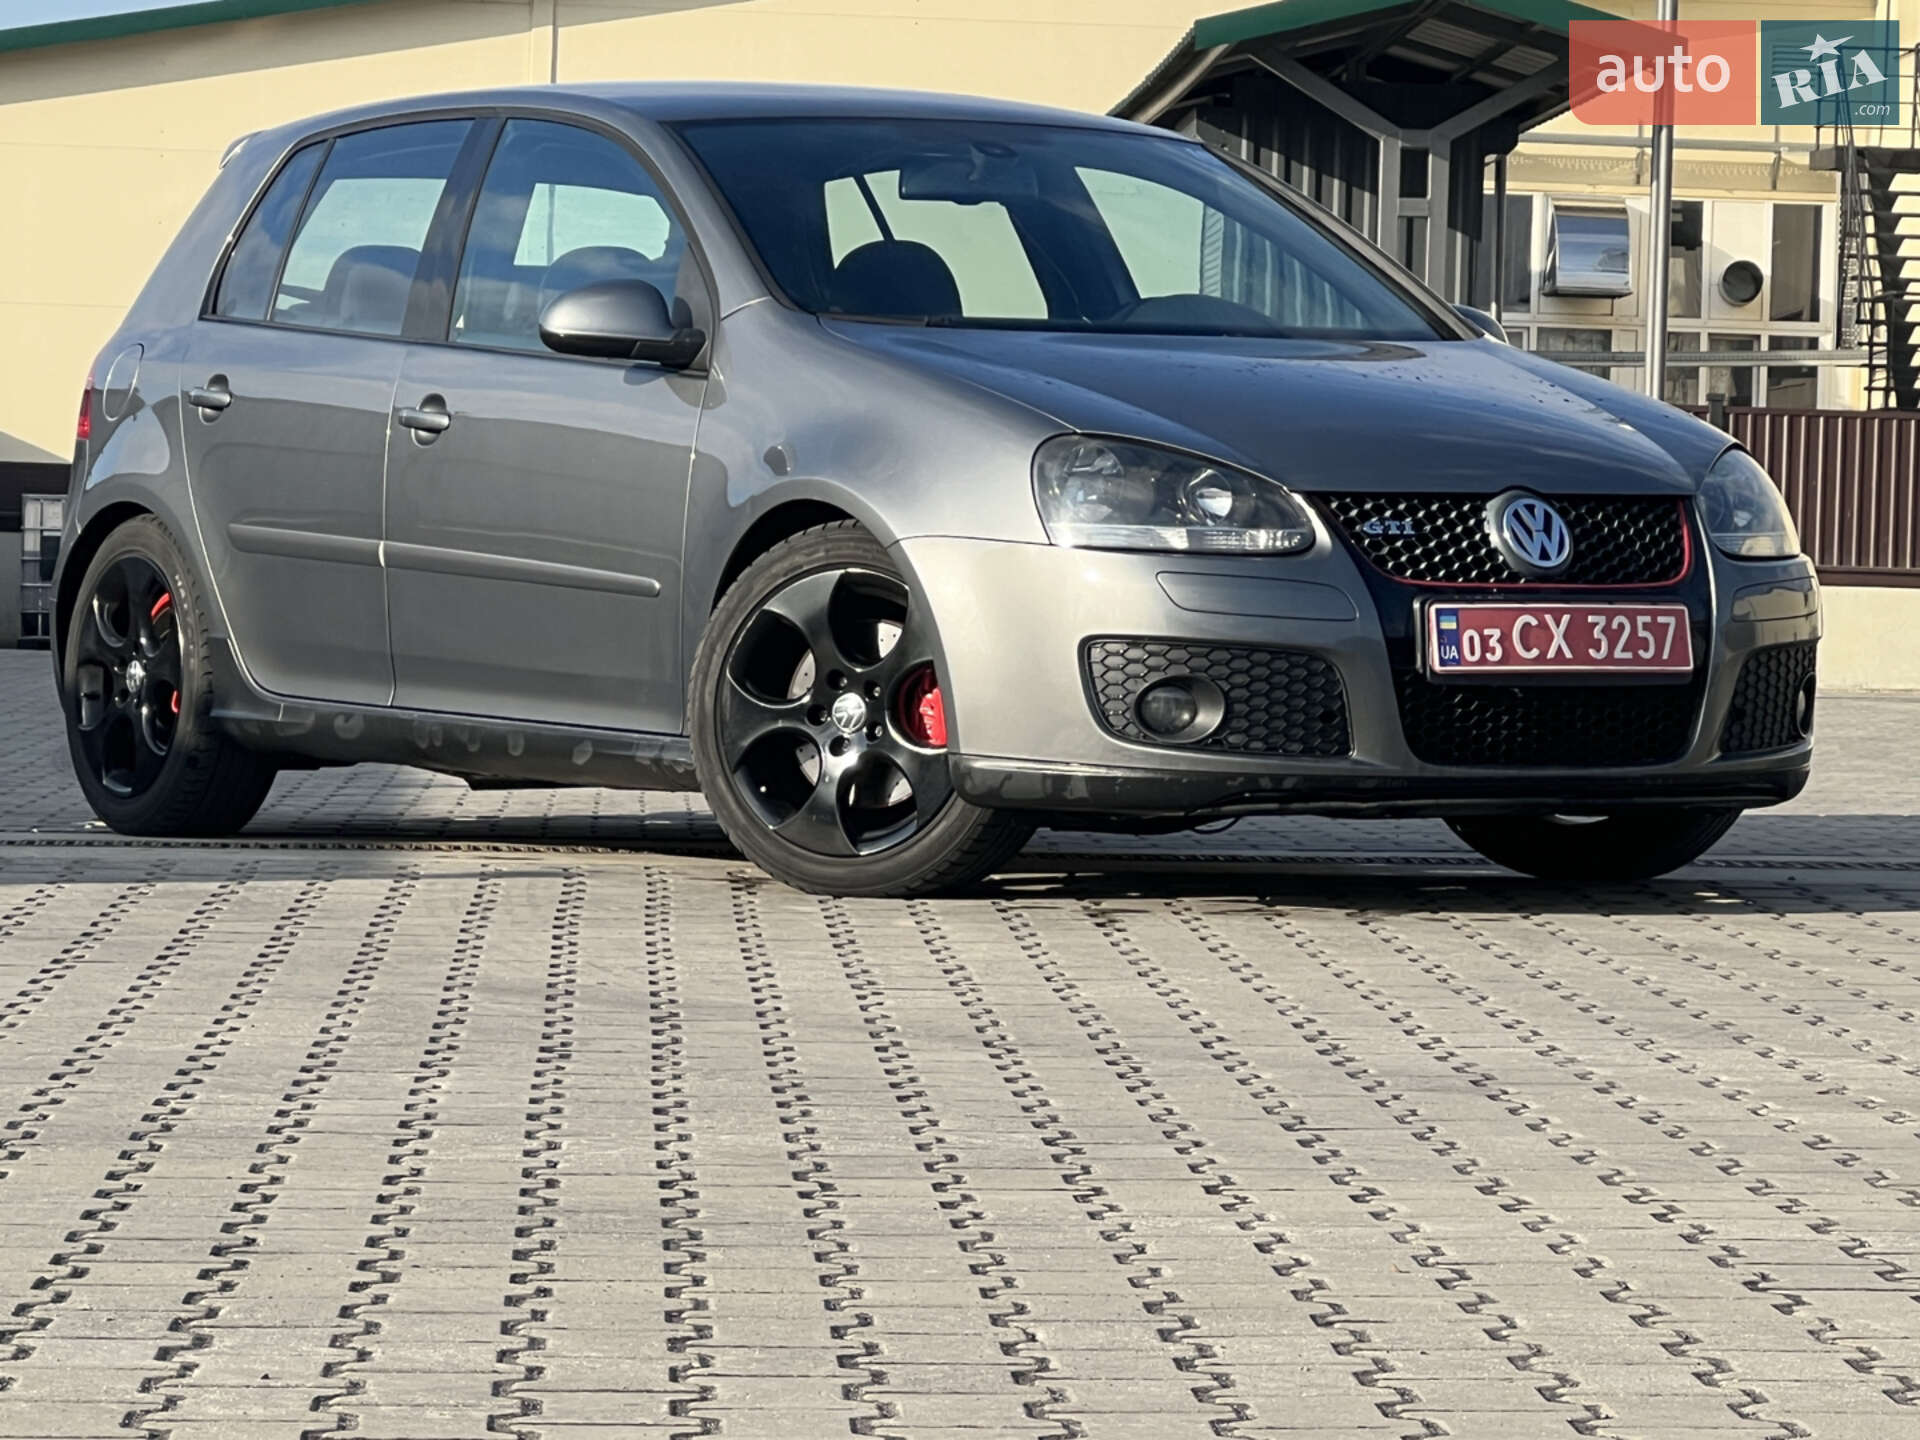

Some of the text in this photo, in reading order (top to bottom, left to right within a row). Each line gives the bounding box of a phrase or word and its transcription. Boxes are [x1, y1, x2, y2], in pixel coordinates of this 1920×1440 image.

[1440, 645, 1459, 660] UA
[1462, 613, 1677, 663] 03 CX 3257
